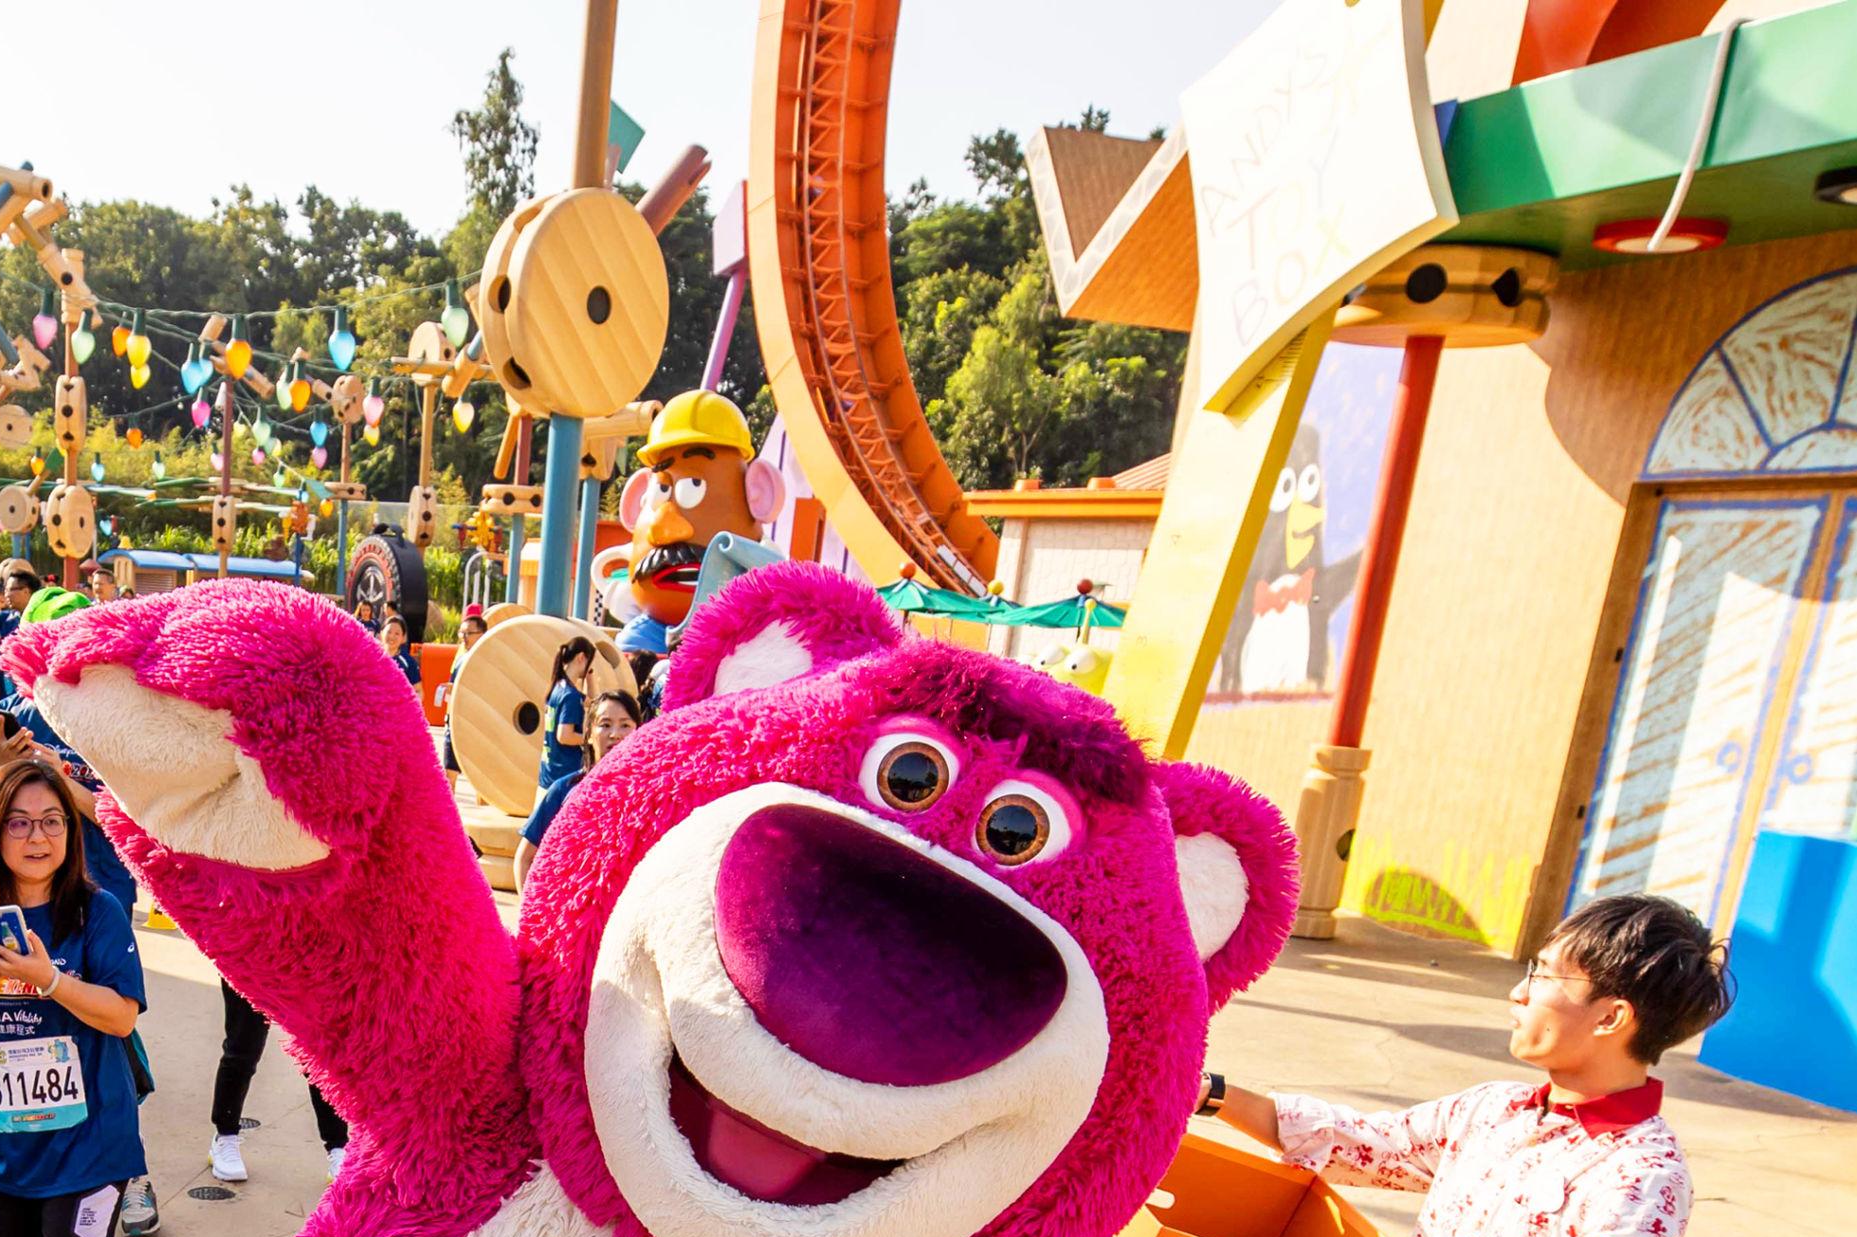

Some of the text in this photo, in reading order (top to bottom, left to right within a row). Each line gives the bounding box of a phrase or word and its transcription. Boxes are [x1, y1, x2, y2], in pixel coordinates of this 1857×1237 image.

[1224, 125, 1340, 271] TOY
[1232, 200, 1353, 347] BOX
[13, 1010, 43, 1025] Vitality
